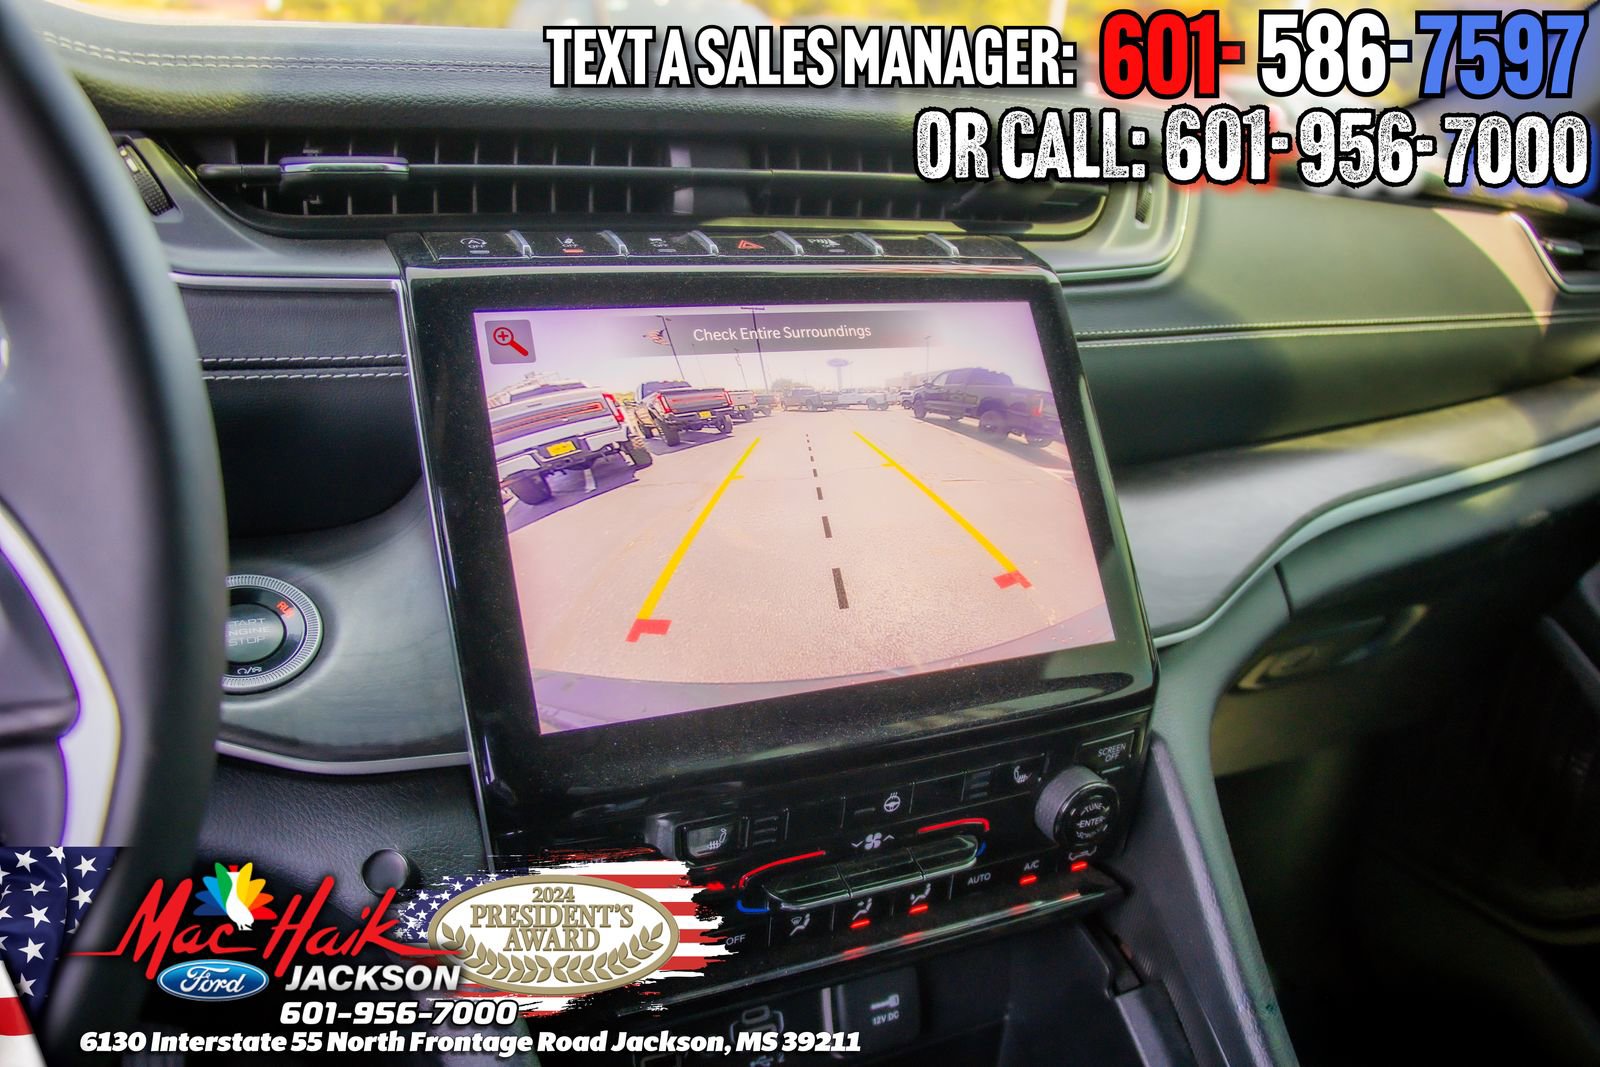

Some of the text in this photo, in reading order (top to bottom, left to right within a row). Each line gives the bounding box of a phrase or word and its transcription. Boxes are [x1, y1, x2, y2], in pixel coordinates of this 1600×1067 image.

[693, 325, 872, 342] Check Entire Surroundings
[228, 617, 266, 627] TART
[228, 626, 272, 637] NGINE
[228, 636, 265, 647] STOP
[1098, 743, 1127, 757] SCREEN
[1105, 753, 1121, 762] OFF
[1079, 816, 1105, 828] ENTER
[1024, 860, 1040, 871] A/C
[967, 873, 992, 886] AUTO
[726, 934, 746, 946] OFF
[872, 1014, 887, 1025] 12V
